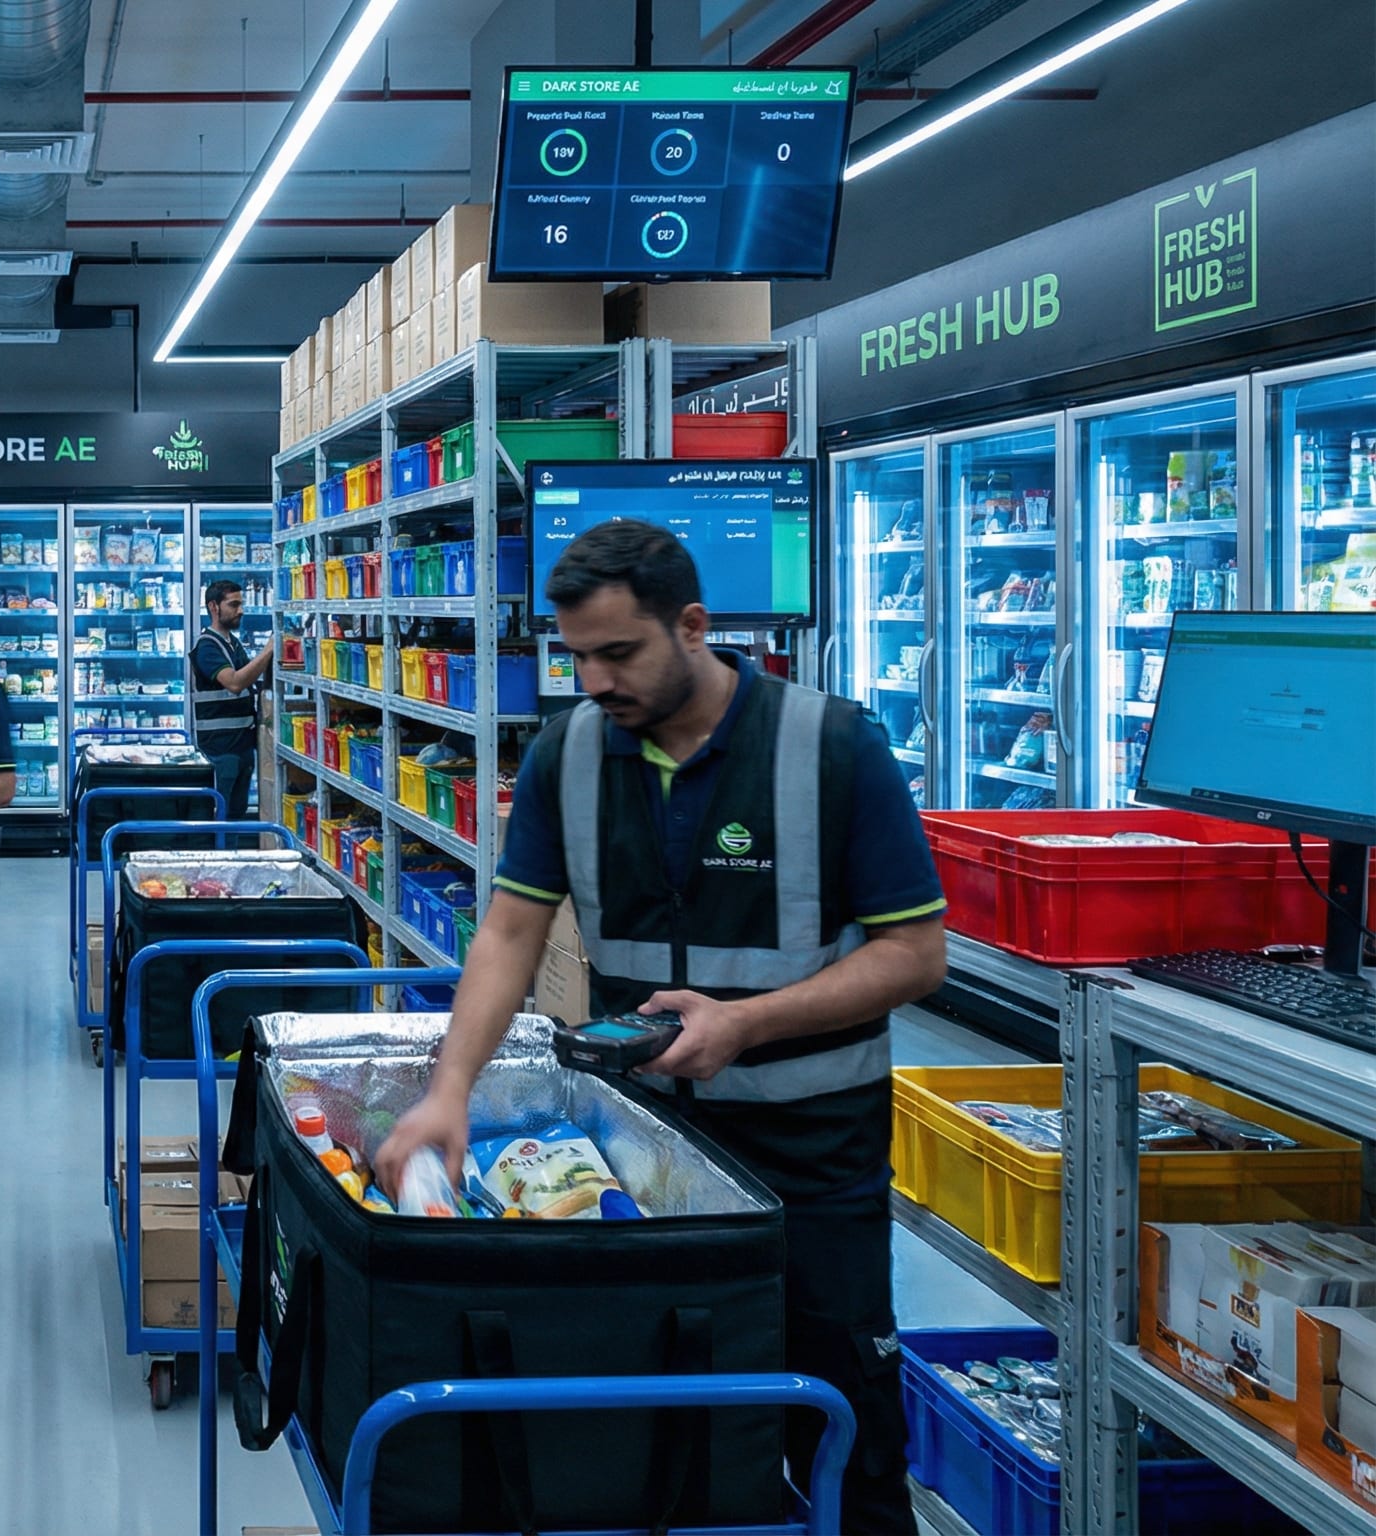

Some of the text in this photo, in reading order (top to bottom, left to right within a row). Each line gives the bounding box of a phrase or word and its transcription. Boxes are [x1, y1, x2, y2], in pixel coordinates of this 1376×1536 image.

[542, 81, 640, 92] DARK STORE AE
[665, 147, 683, 159] 20
[777, 143, 791, 161] 0
[544, 224, 568, 244] 16
[1164, 209, 1245, 266] FRESH
[1165, 259, 1224, 308] HUB
[860, 272, 1060, 376] FRESH HUB
[54, 437, 96, 461] AE
